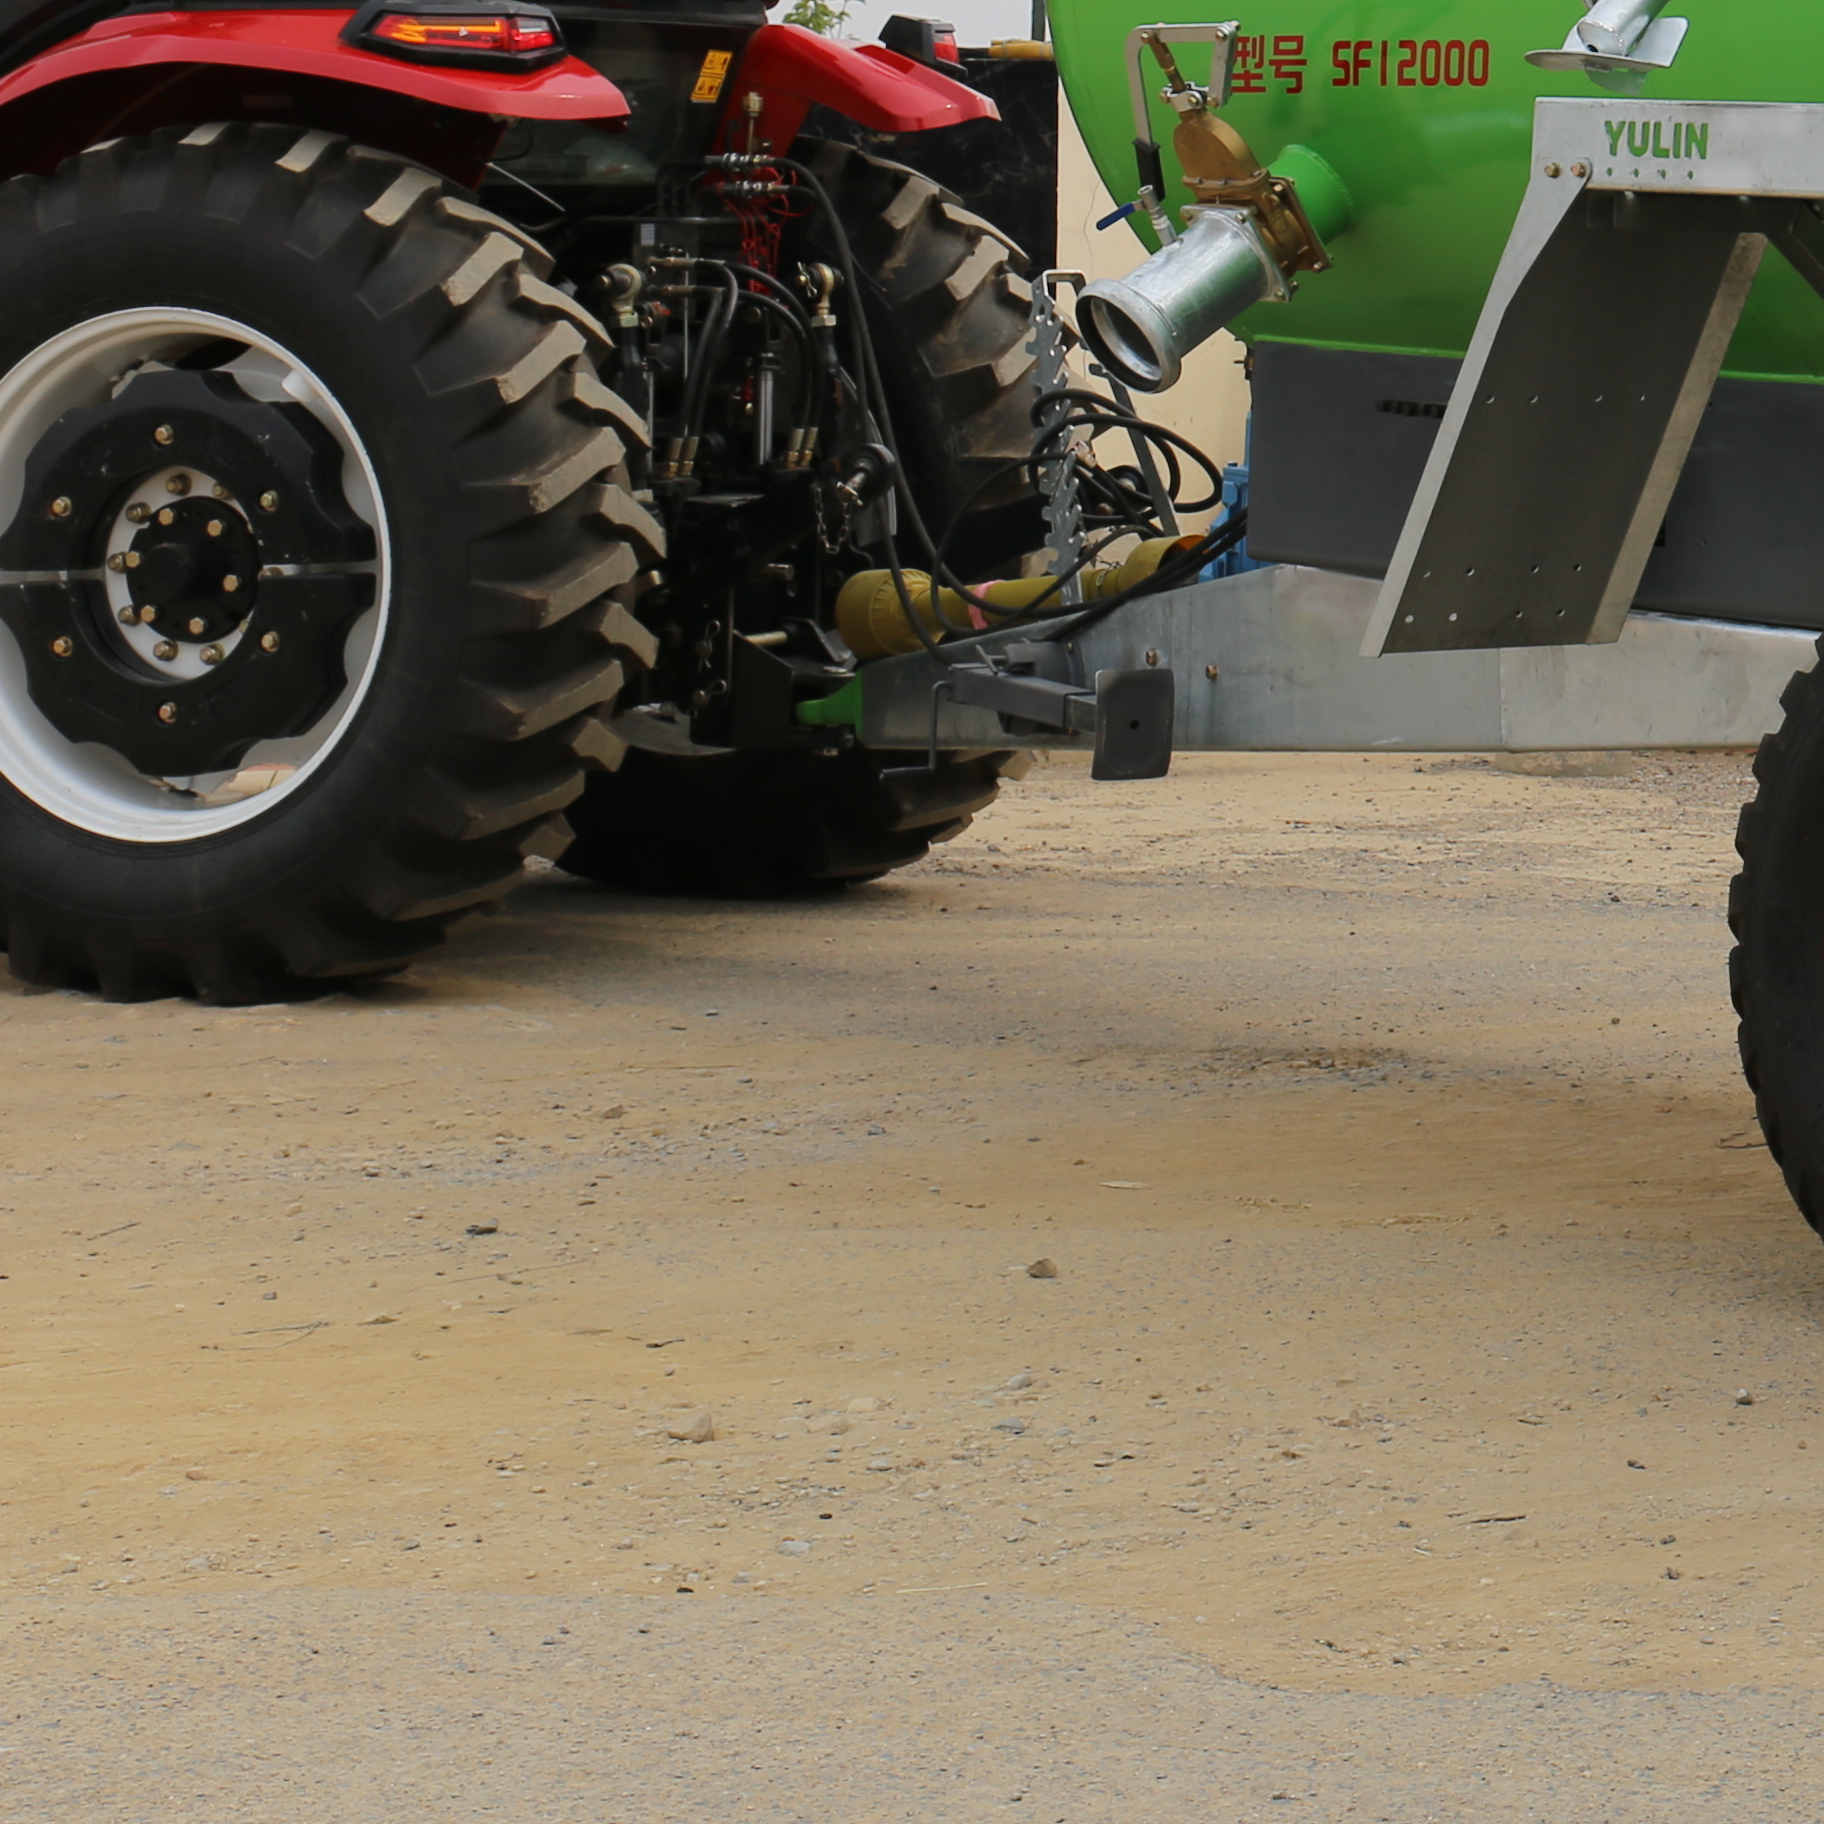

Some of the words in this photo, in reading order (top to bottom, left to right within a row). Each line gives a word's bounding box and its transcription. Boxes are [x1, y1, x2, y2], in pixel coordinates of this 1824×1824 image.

[1231, 34, 1307, 94] 型号
[1331, 39, 1490, 87] SF12000
[1603, 119, 1709, 161] YULIN
